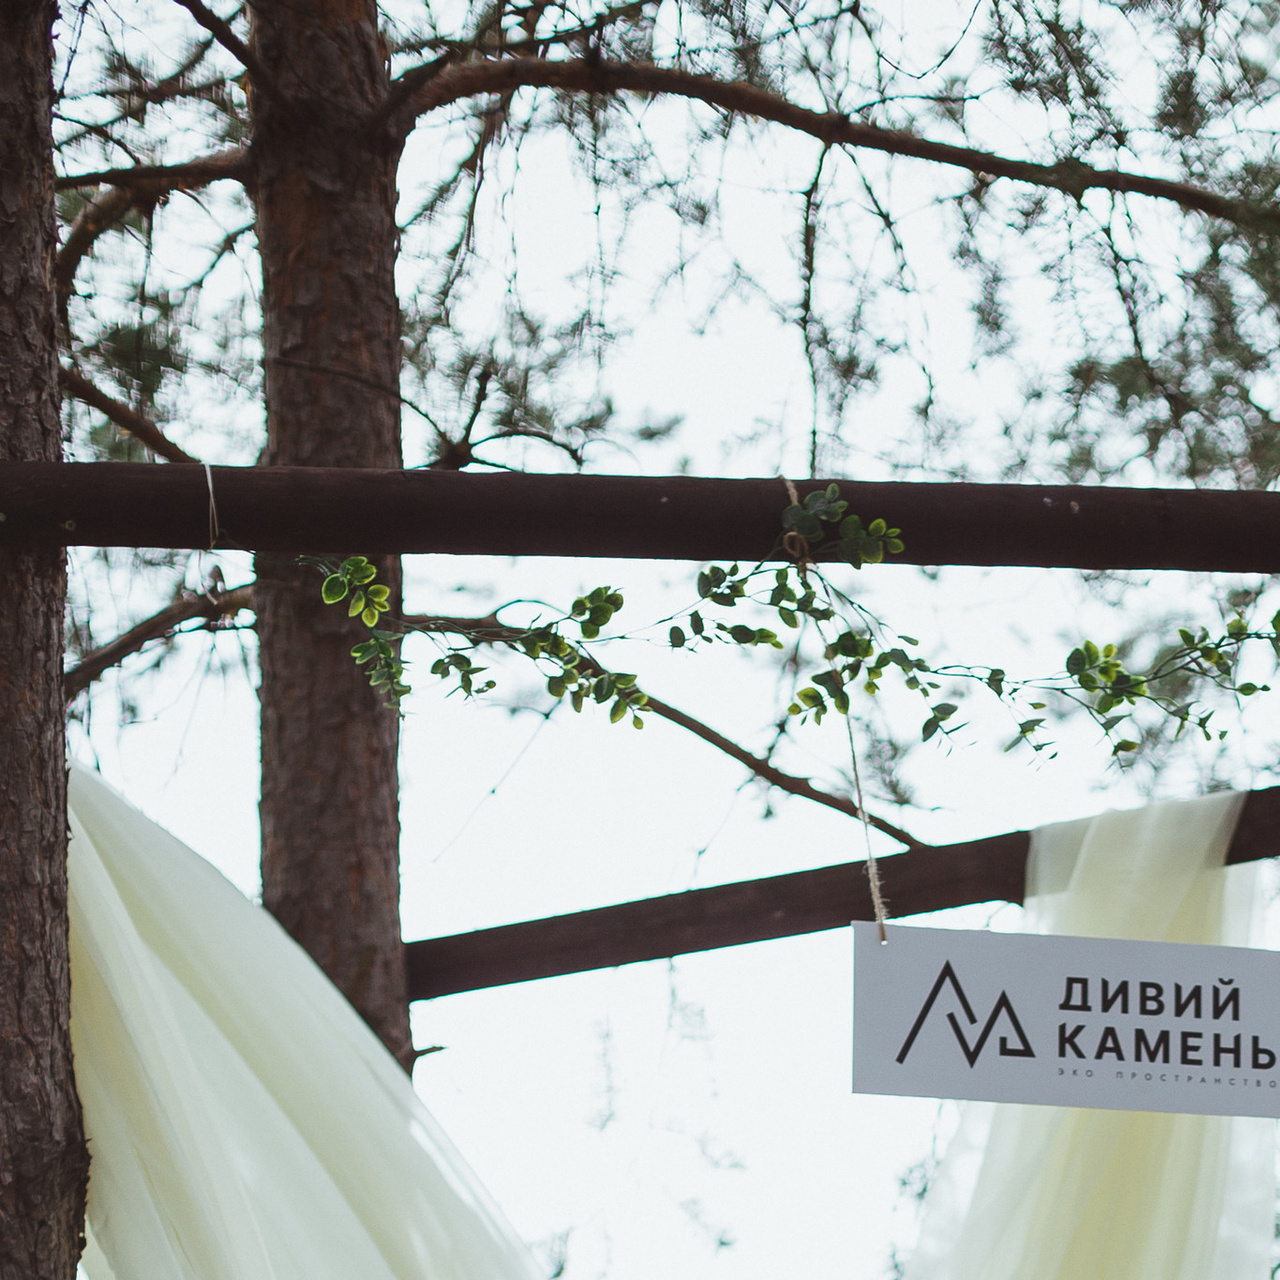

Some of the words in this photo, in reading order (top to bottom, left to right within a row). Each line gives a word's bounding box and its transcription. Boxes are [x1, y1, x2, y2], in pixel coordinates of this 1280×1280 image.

[1057, 976, 1241, 1022] ДИВИЙ
[1057, 1022, 1277, 1070] КАМЕНЬ
[1057, 1067, 1095, 1078] ЭКО
[1115, 1070, 1278, 1089] ПРОСТРАНСТВО
